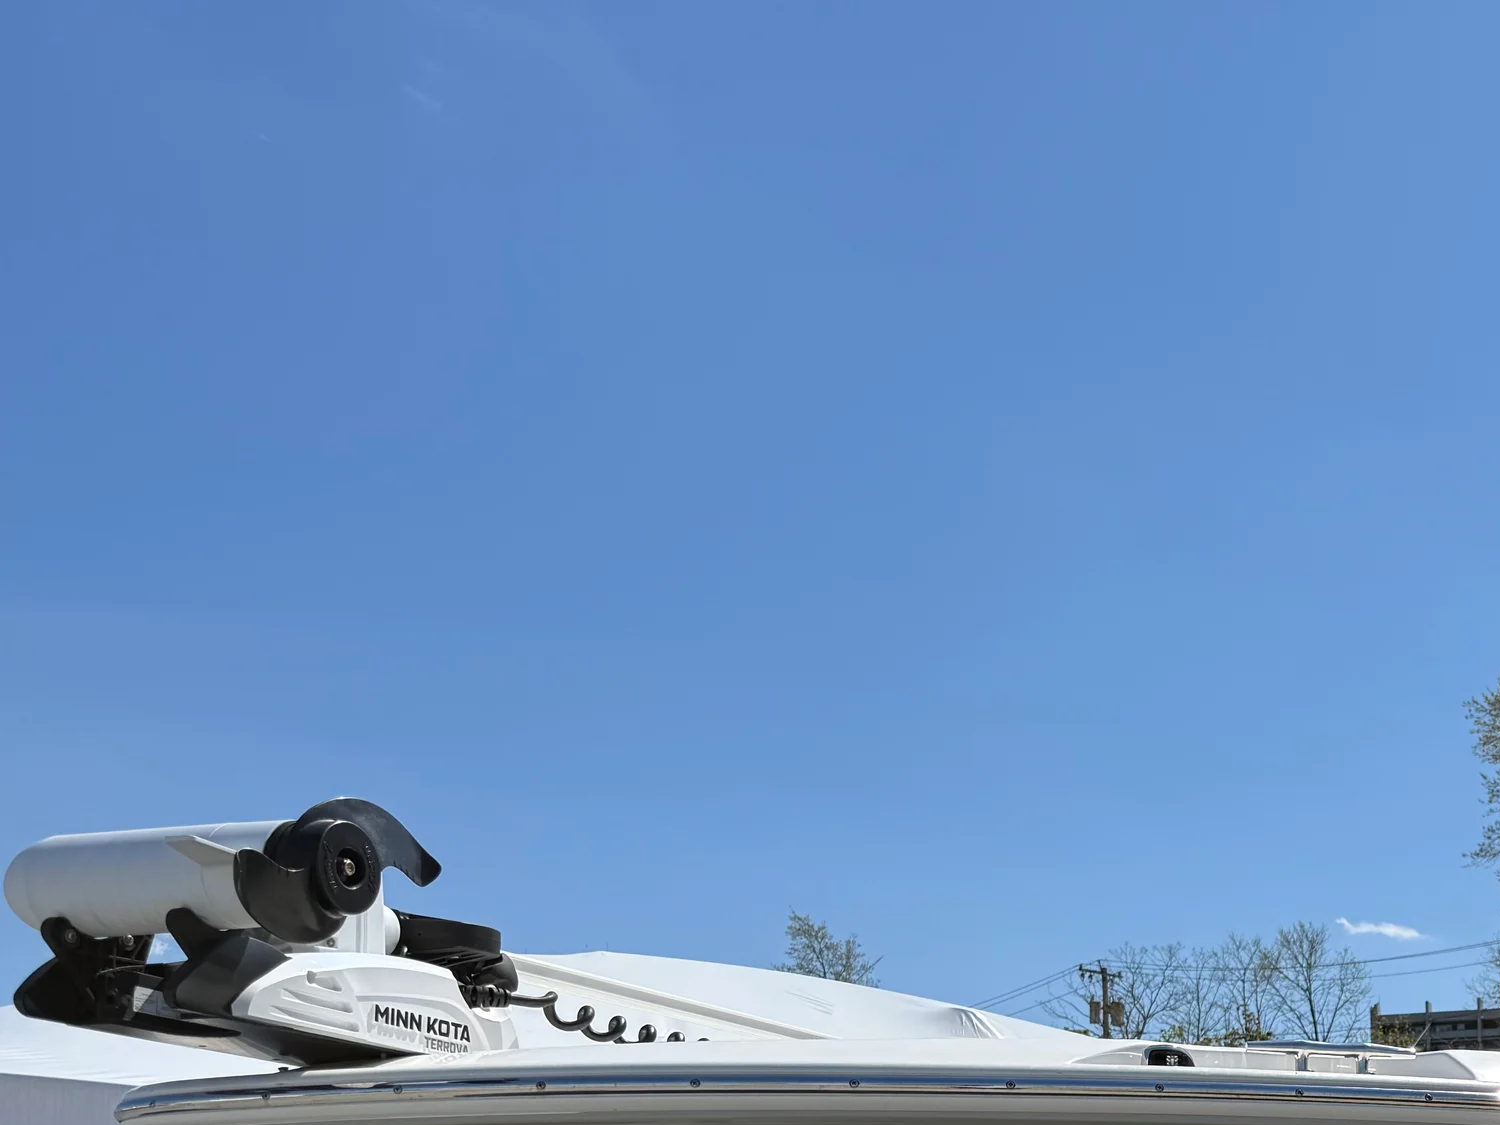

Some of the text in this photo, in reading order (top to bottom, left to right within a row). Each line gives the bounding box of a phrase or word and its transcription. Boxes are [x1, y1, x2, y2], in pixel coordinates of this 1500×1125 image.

[374, 1003, 471, 1043] MINN KOTA
[424, 1035, 469, 1054] TERROVA
